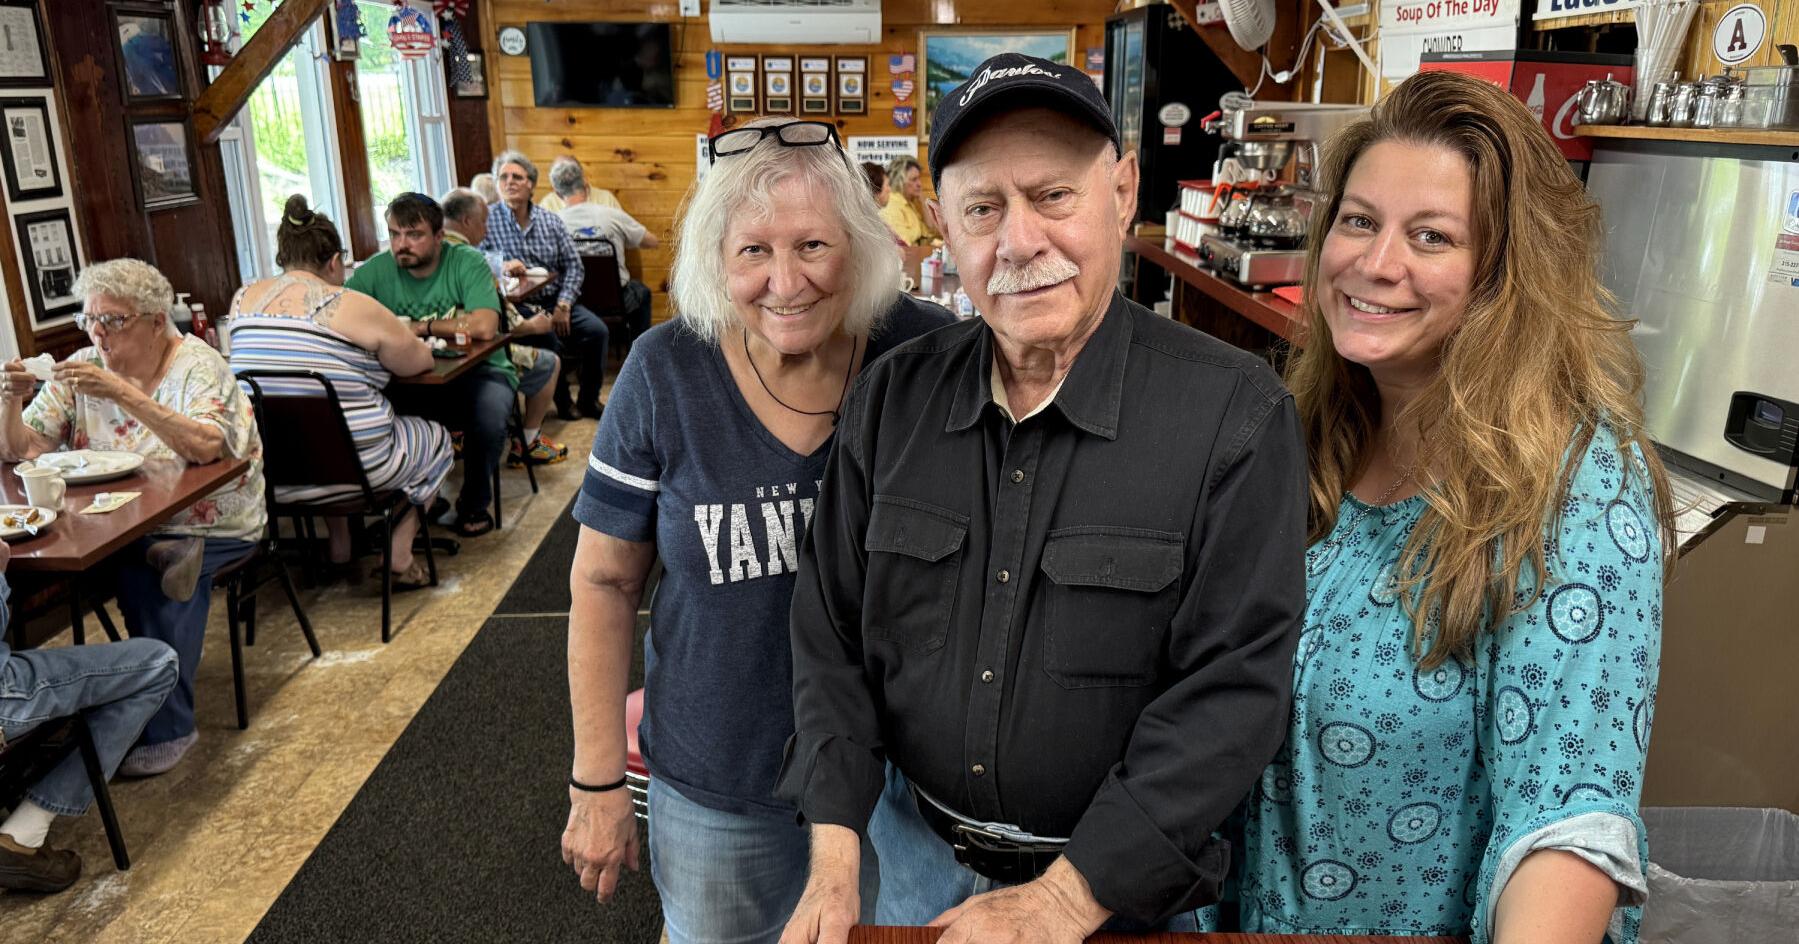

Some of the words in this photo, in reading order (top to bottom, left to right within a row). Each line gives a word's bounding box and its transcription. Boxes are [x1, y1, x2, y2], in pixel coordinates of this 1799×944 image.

[1396, 6, 1423, 24] Soup
[1426, 1, 1442, 18] Of
[1444, 0, 1469, 17] The
[1472, 0, 1500, 16] Day
[1422, 35, 1463, 52] CHOWDER
[1727, 18, 1747, 52] A
[756, 482, 797, 498] NEW
